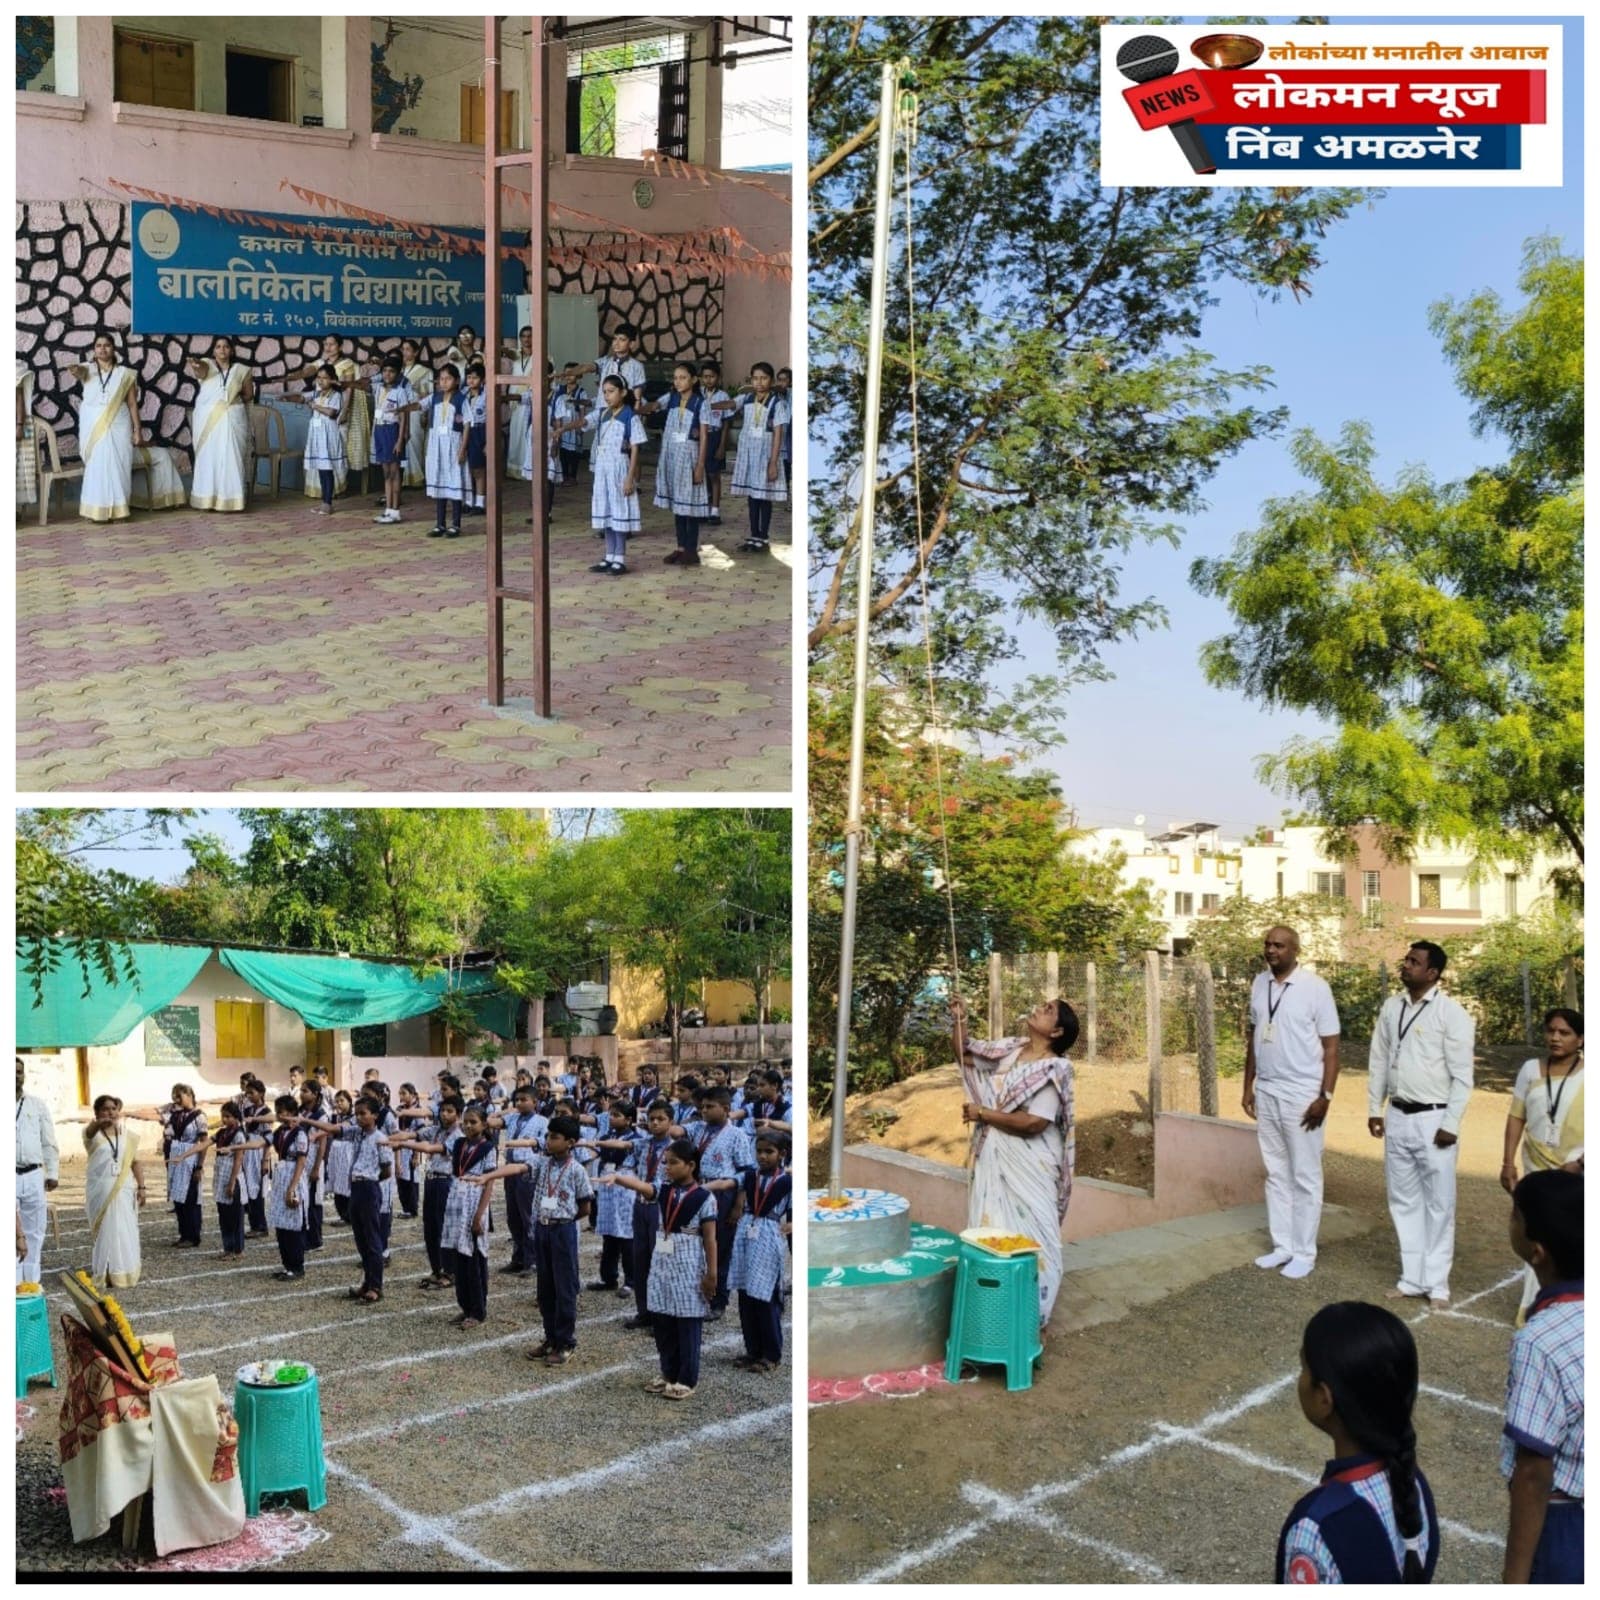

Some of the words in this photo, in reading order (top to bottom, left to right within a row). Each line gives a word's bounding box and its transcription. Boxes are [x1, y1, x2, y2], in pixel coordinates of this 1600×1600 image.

[238, 235, 304, 255] कमल
[311, 240, 397, 260] राजाराम
[157, 257, 333, 303] बालनिकेतन
[341, 263, 462, 307] विद्यामंदिर
[238, 312, 259, 327] गट
